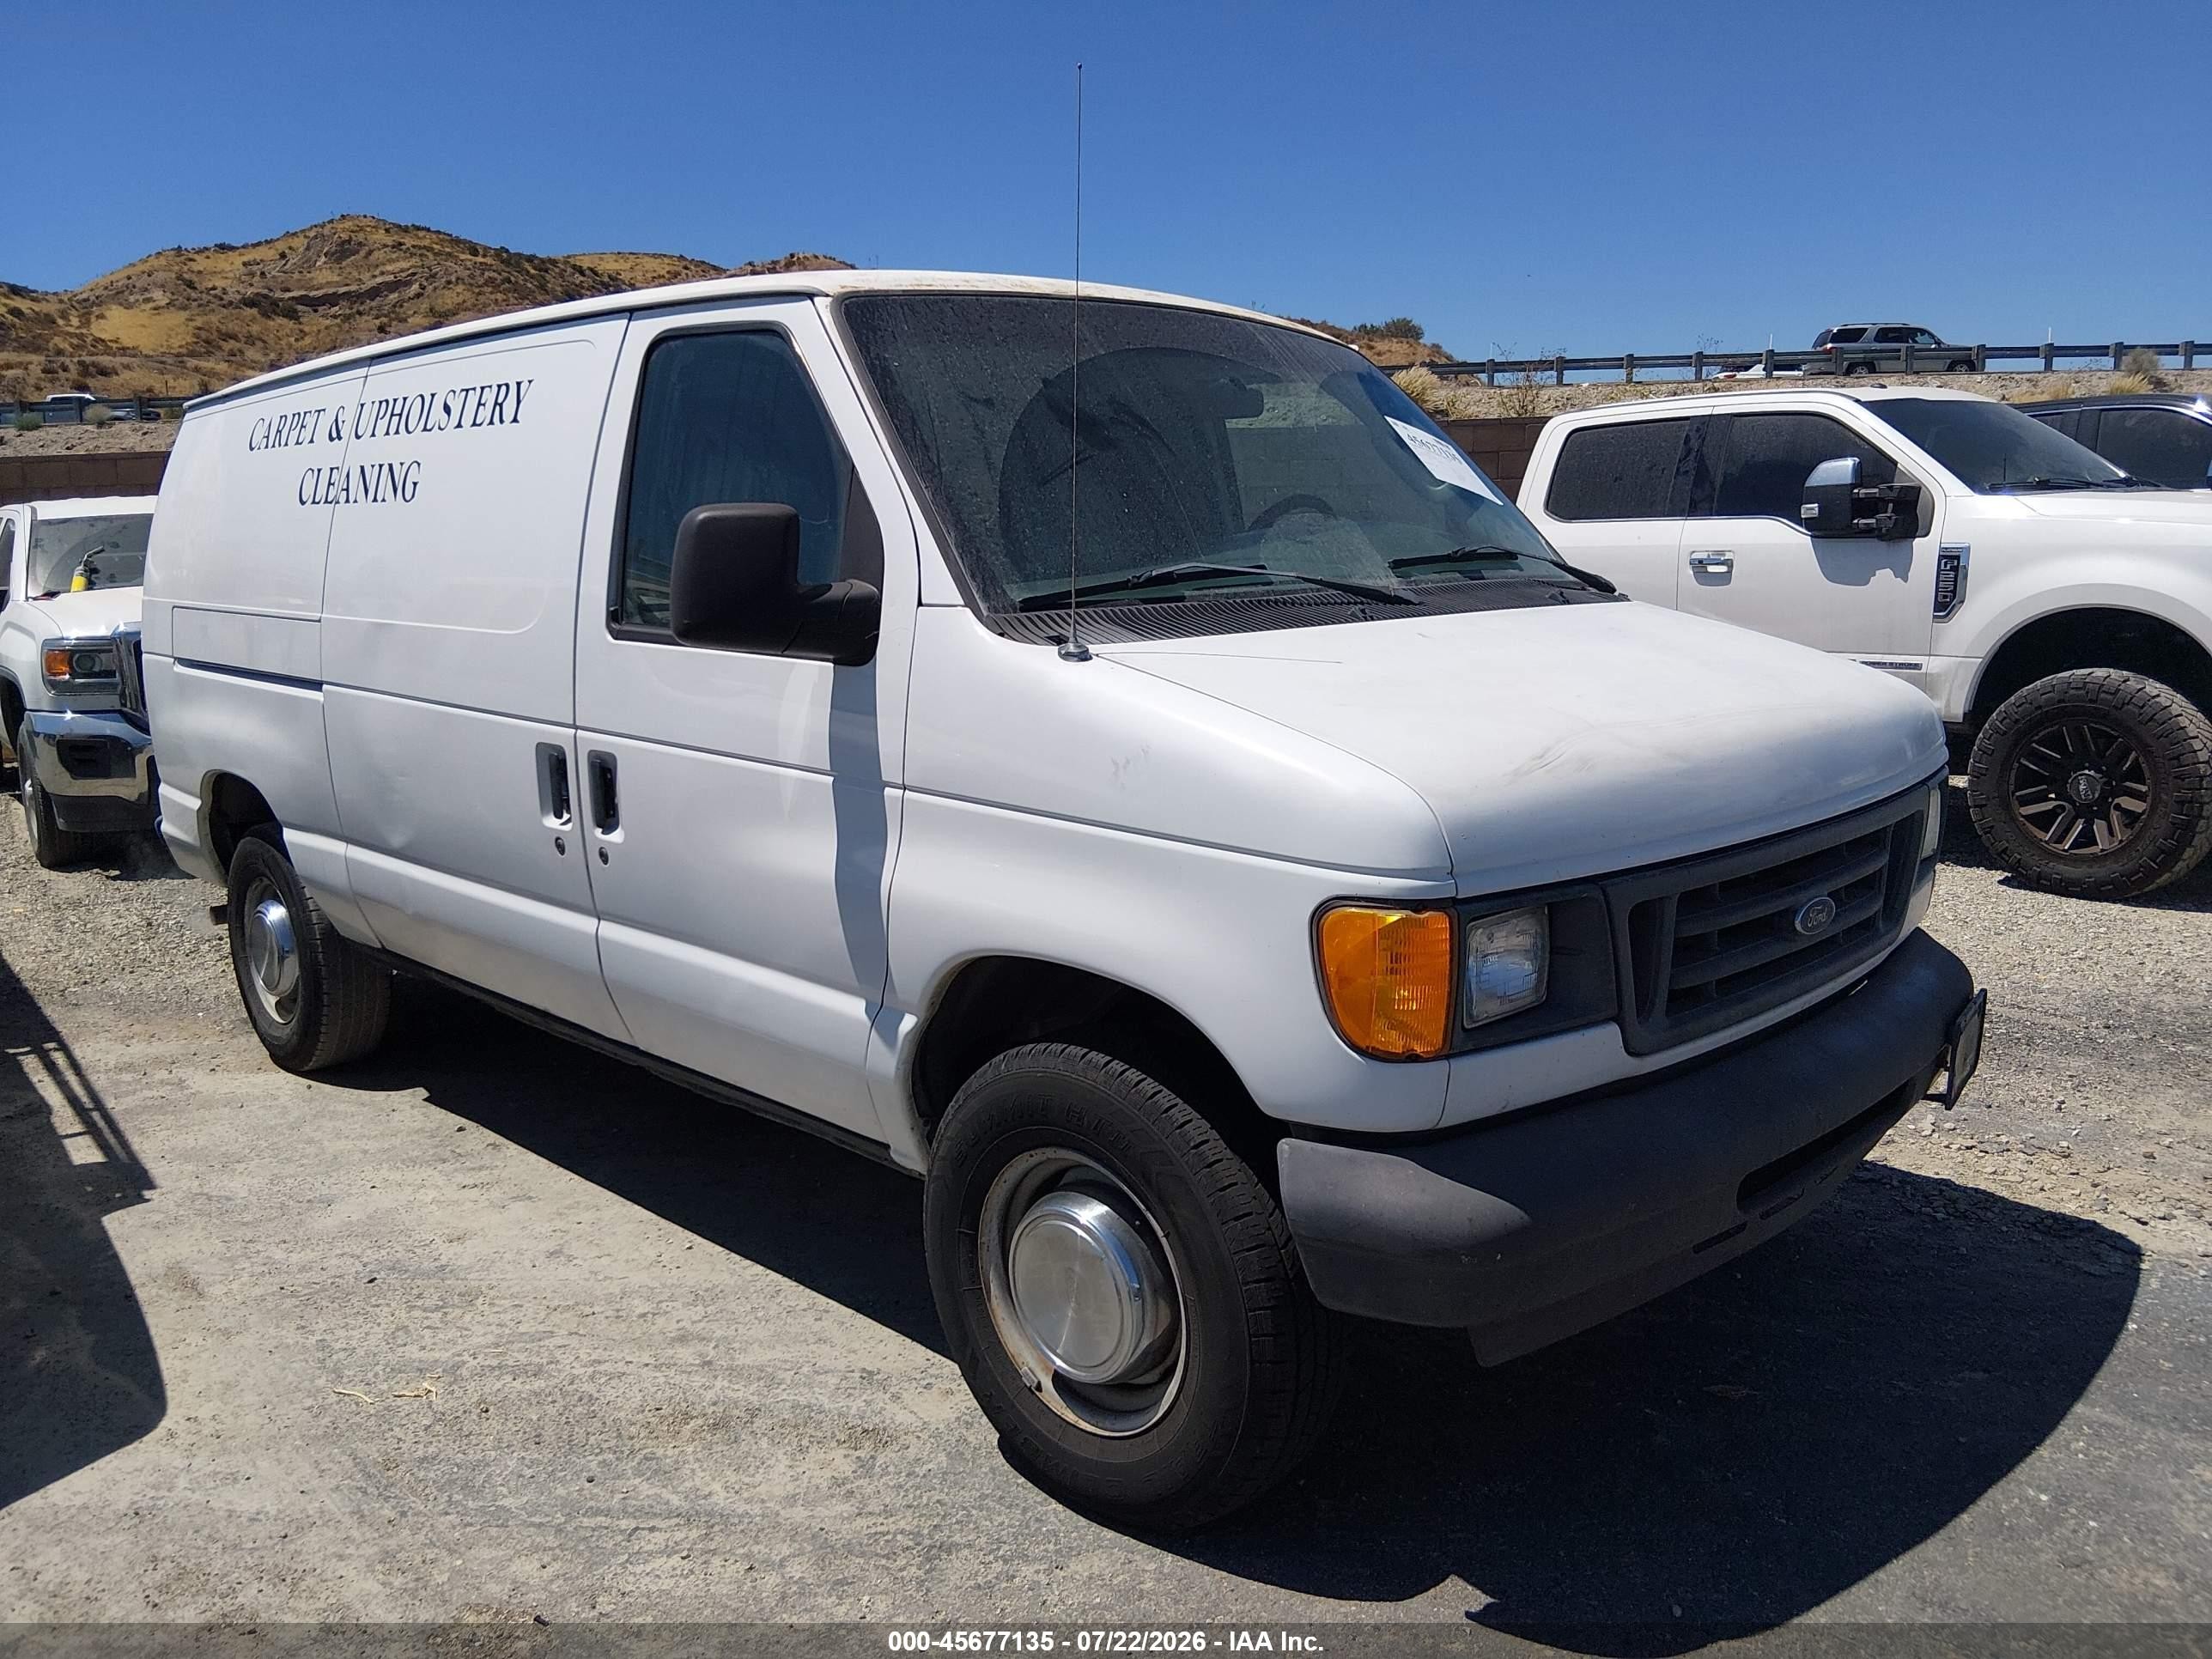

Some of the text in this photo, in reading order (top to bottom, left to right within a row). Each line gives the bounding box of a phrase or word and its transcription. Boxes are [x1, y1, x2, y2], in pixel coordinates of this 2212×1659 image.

[248, 379, 534, 452] CARPET & UPHOLSTERY
[298, 460, 422, 507] CLEANING
